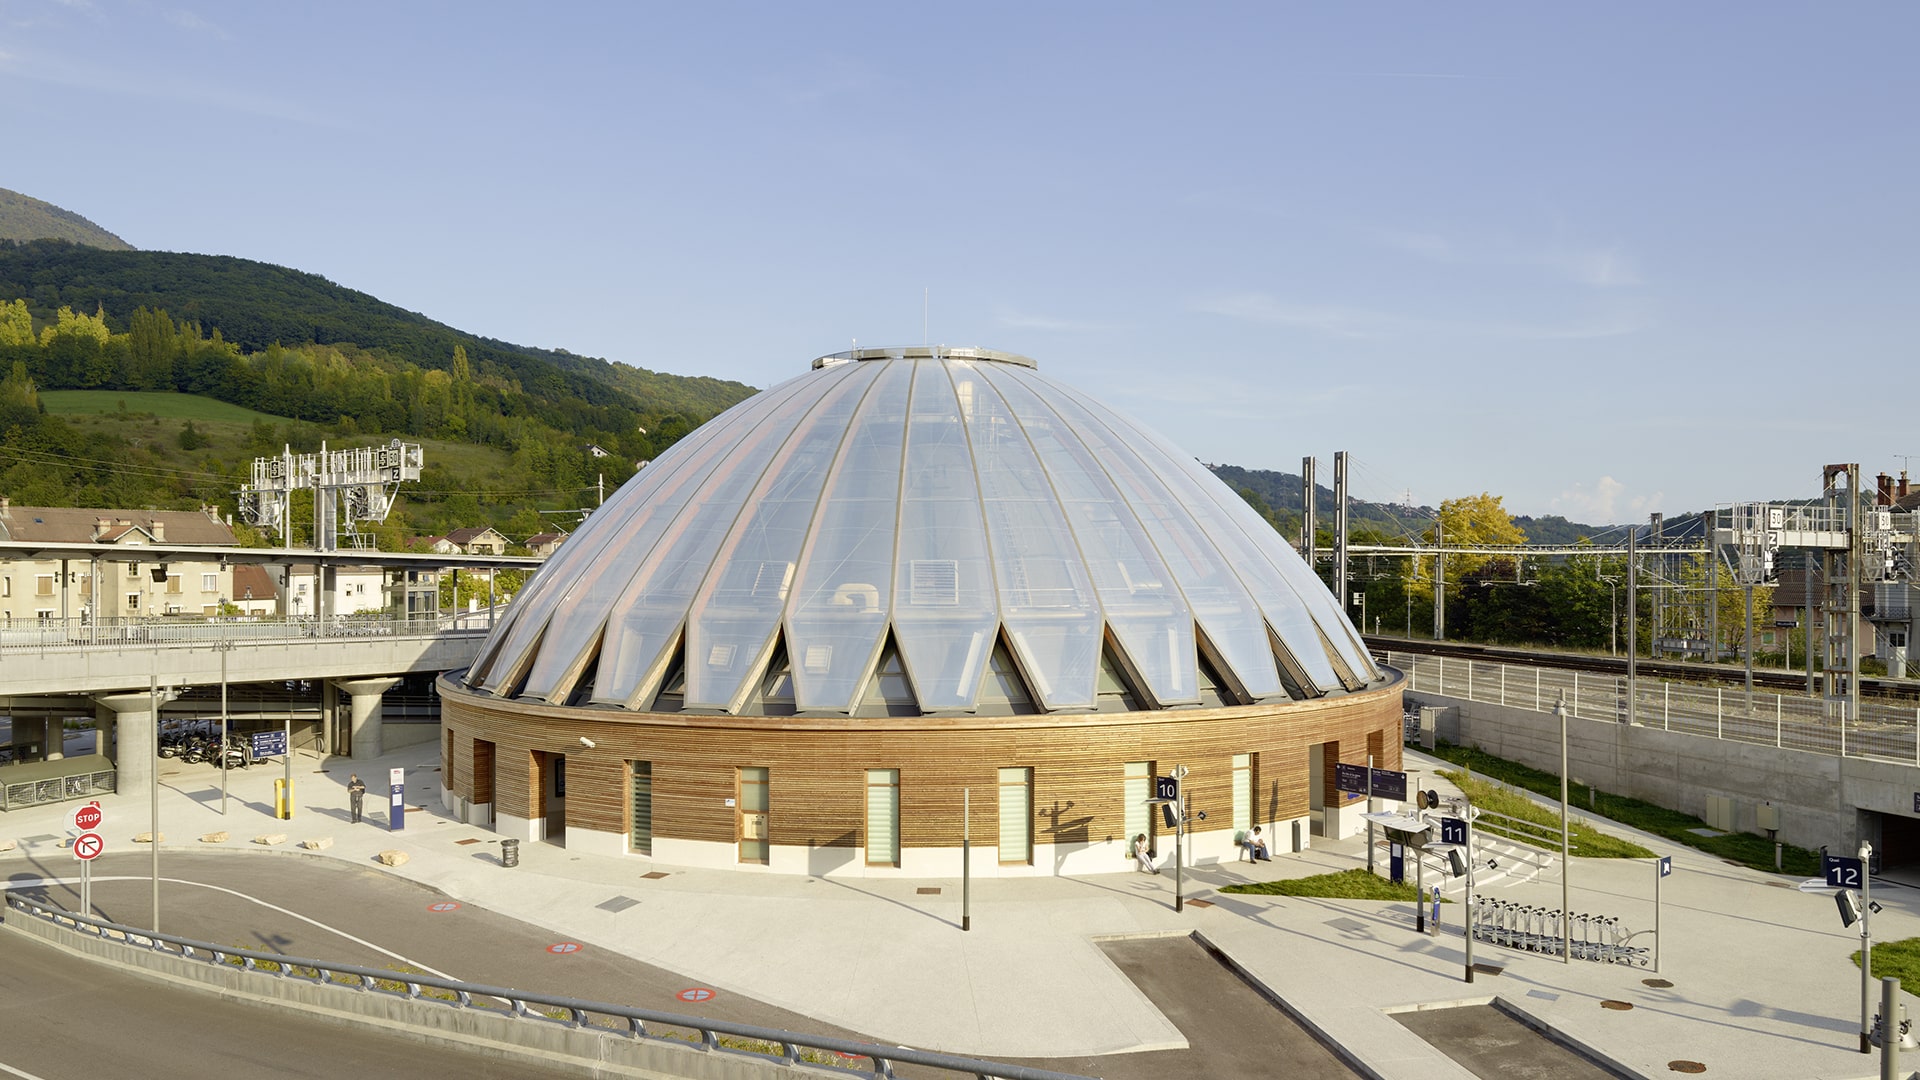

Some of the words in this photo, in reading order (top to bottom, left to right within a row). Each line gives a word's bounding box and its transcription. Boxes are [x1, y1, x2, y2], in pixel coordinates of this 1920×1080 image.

[1769, 534, 1776, 545] Z
[1160, 784, 1175, 797] 10
[77, 813, 100, 824] STOP
[1445, 826, 1462, 842] 11
[1831, 867, 1858, 885] 12
